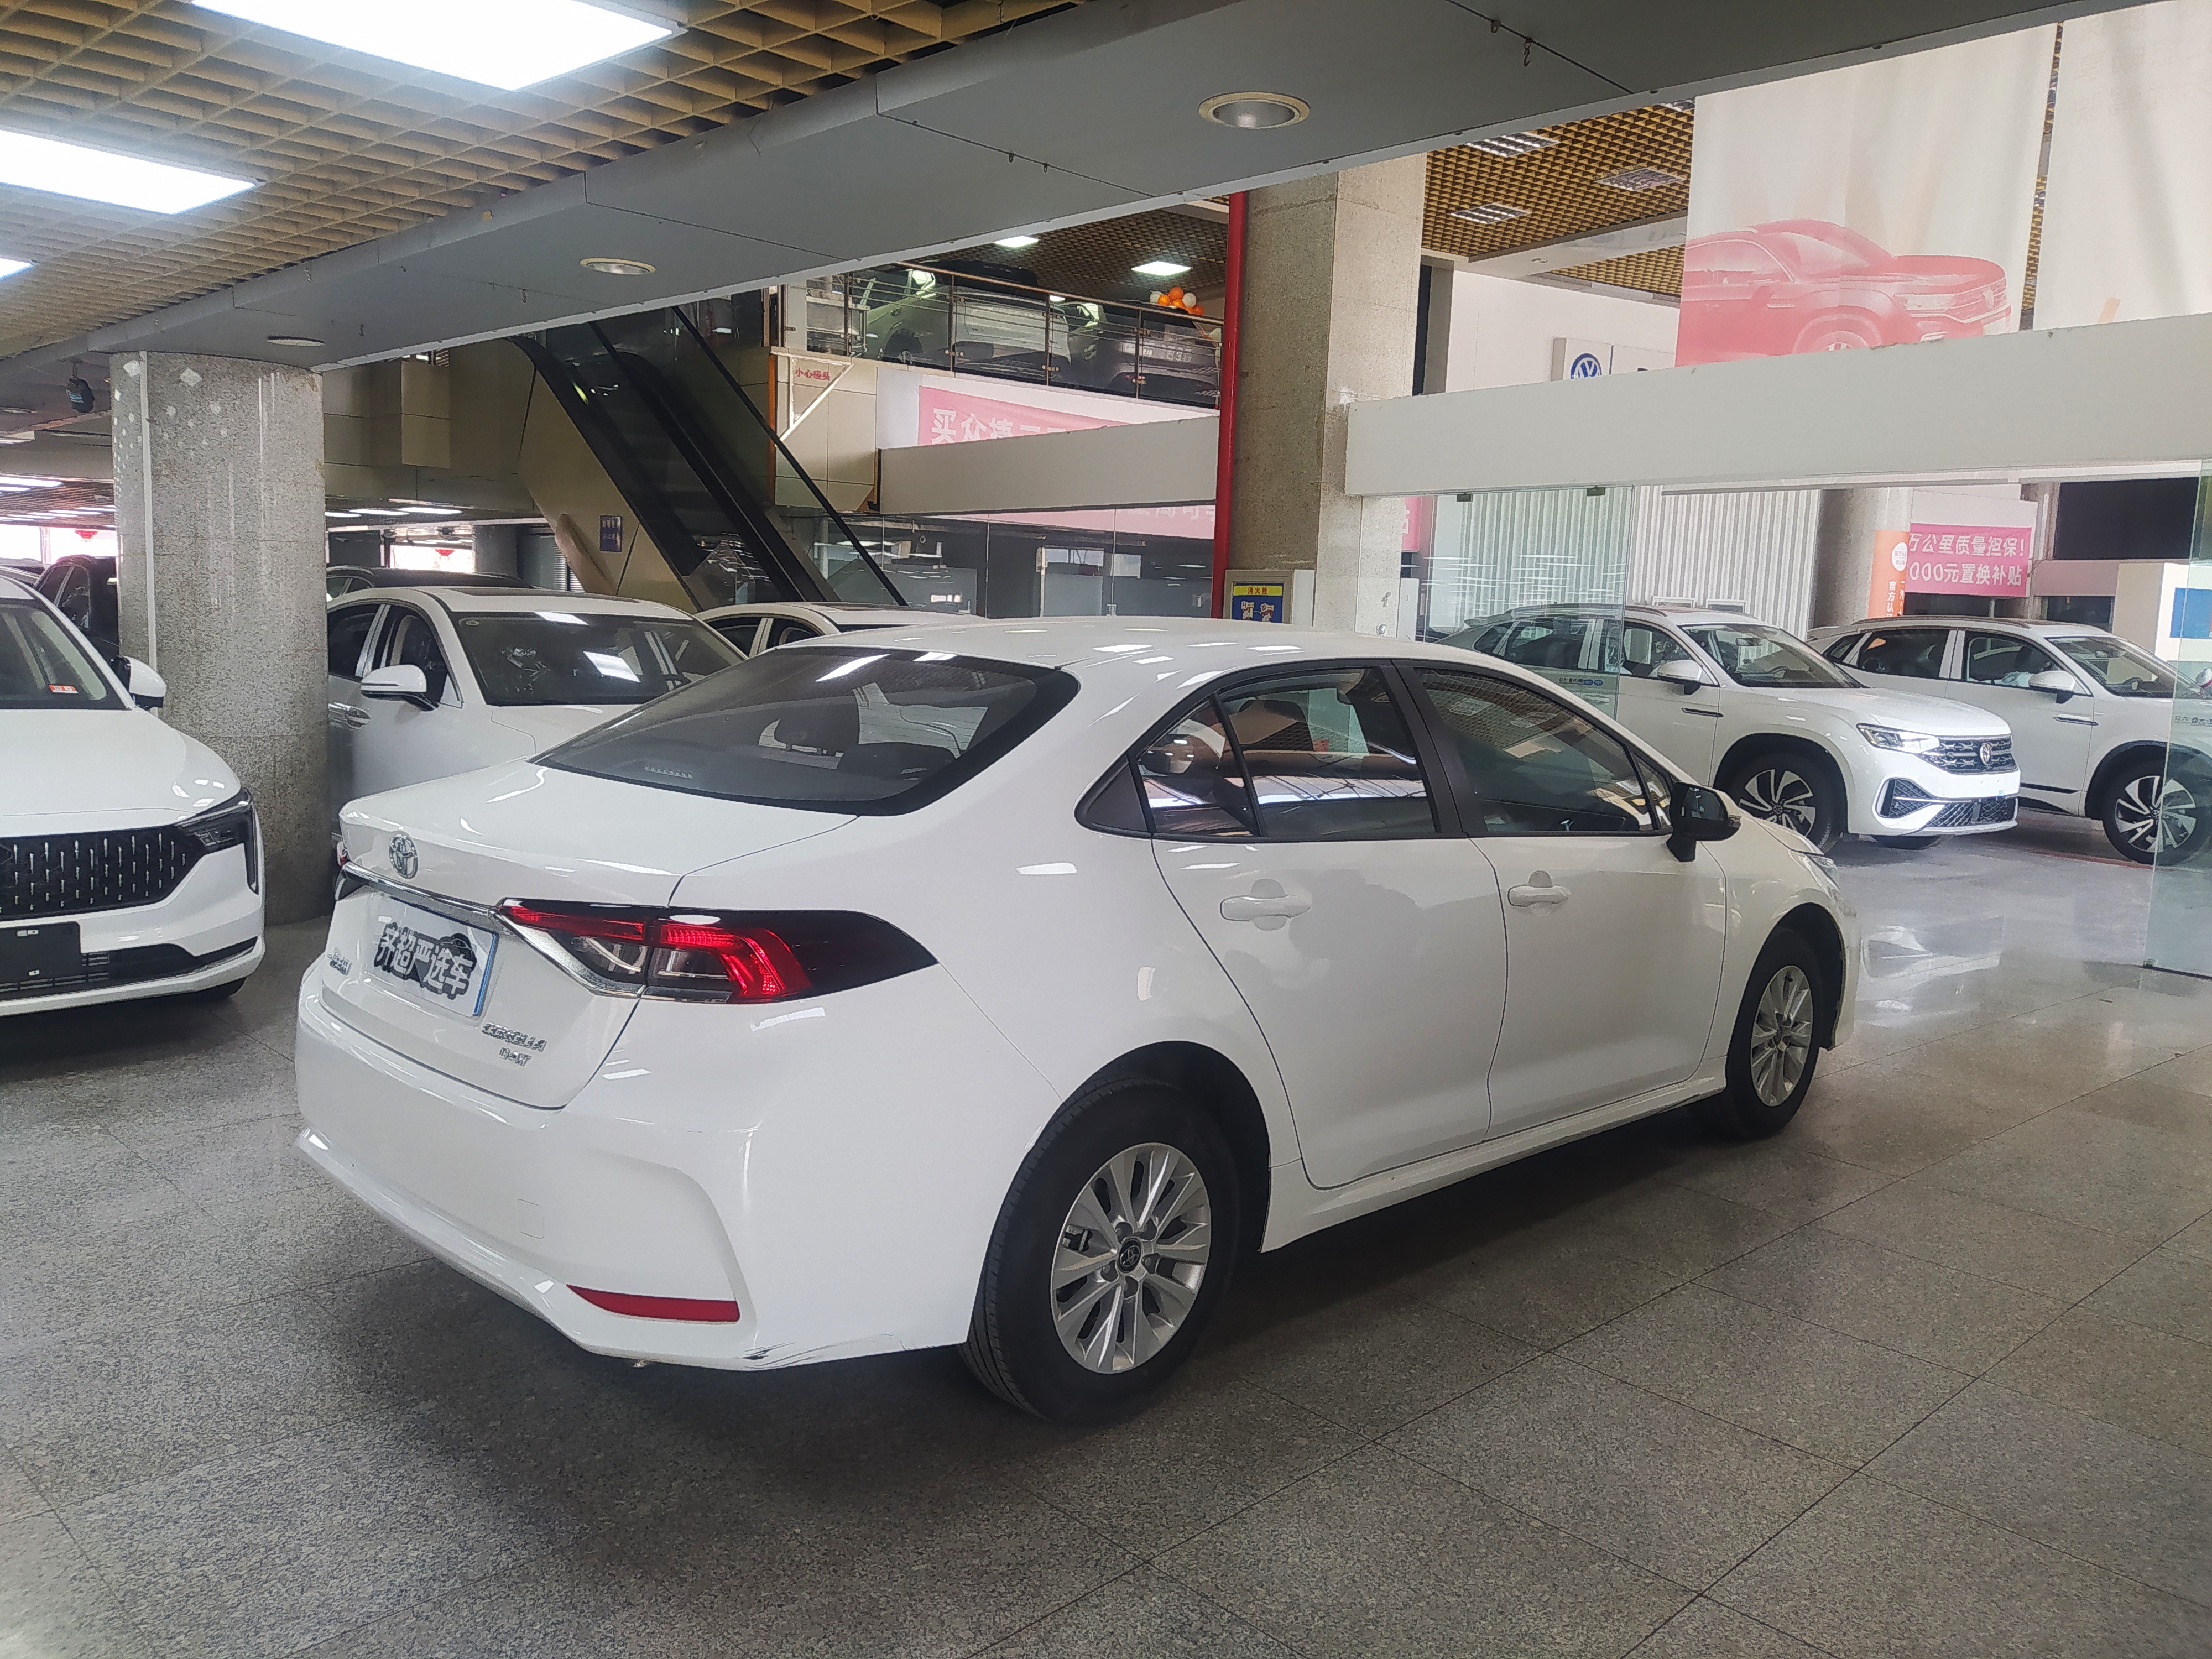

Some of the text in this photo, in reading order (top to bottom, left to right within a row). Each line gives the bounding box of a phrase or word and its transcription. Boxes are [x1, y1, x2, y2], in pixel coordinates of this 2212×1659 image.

[1909, 562, 2022, 586] 000元置换补贴
[1886, 581, 1897, 617] 官方认
